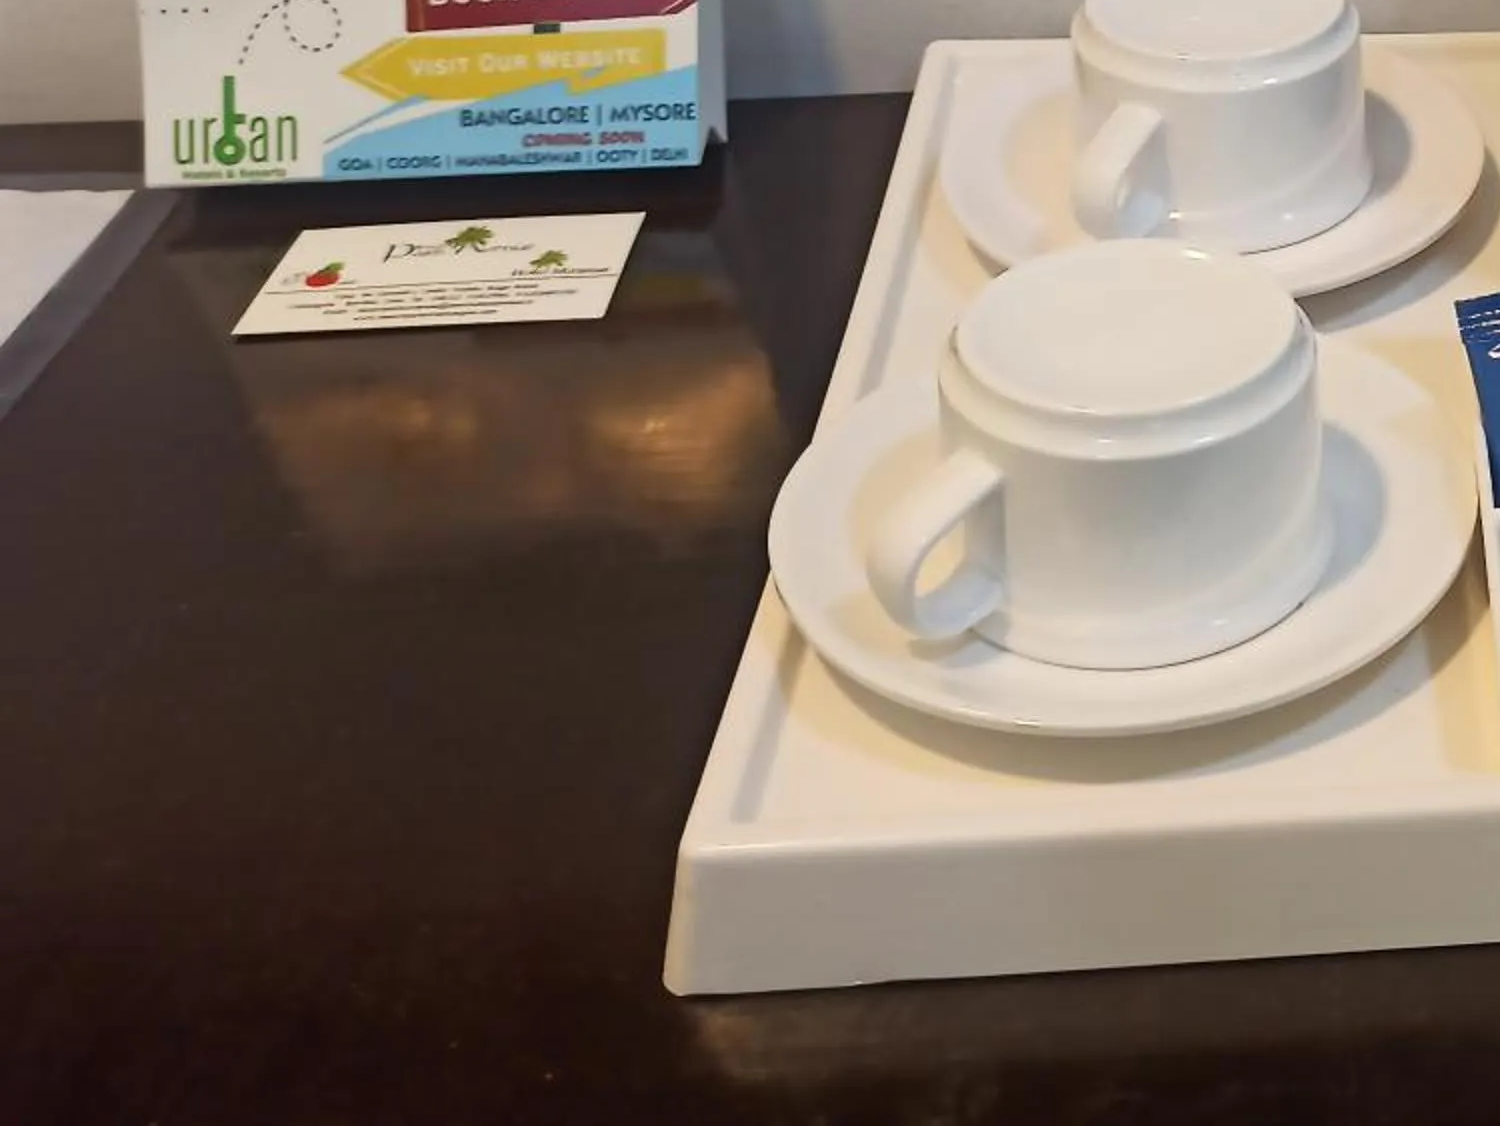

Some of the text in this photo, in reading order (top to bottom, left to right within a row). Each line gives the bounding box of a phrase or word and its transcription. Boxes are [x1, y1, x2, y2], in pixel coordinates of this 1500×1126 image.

[173, 75, 298, 166] urban
[460, 102, 697, 128] BANGALORE MYSORE
